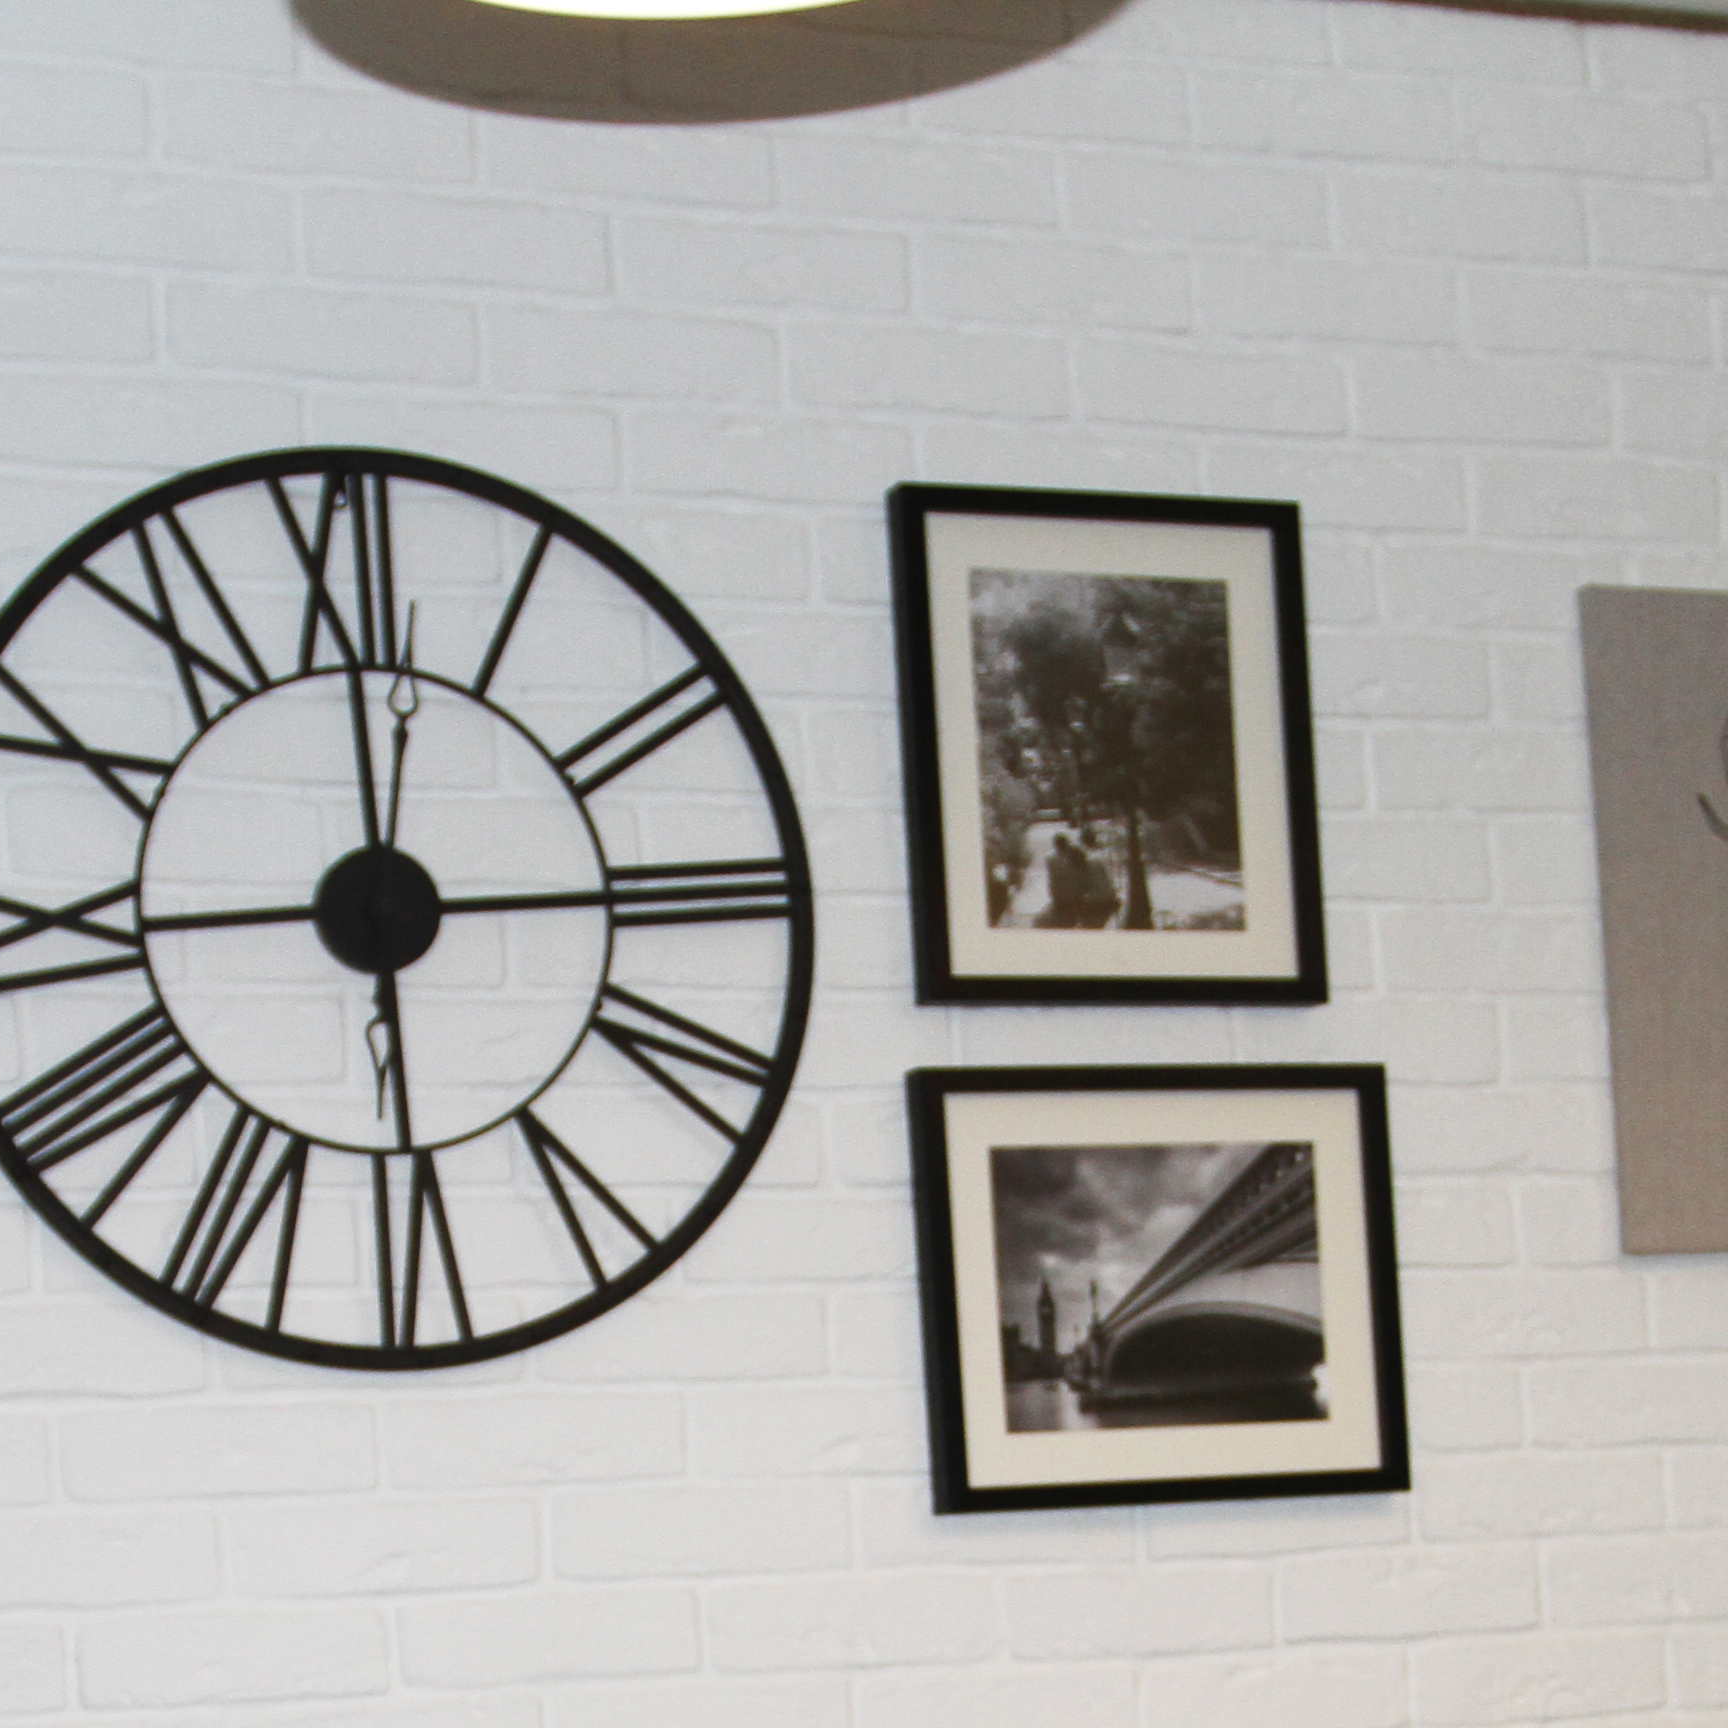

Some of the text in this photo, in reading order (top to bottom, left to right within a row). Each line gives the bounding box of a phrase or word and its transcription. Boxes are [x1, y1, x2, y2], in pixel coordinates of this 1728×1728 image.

[72, 512, 267, 728] XI
[267, 472, 396, 671] XII
[475, 524, 554, 699] I
[556, 664, 728, 795] II
[608, 859, 790, 926] III
[592, 984, 776, 1146] IV
[158, 1104, 308, 1331] VII
[372, 1151, 473, 1346] VI
[522, 1106, 657, 1286] V
